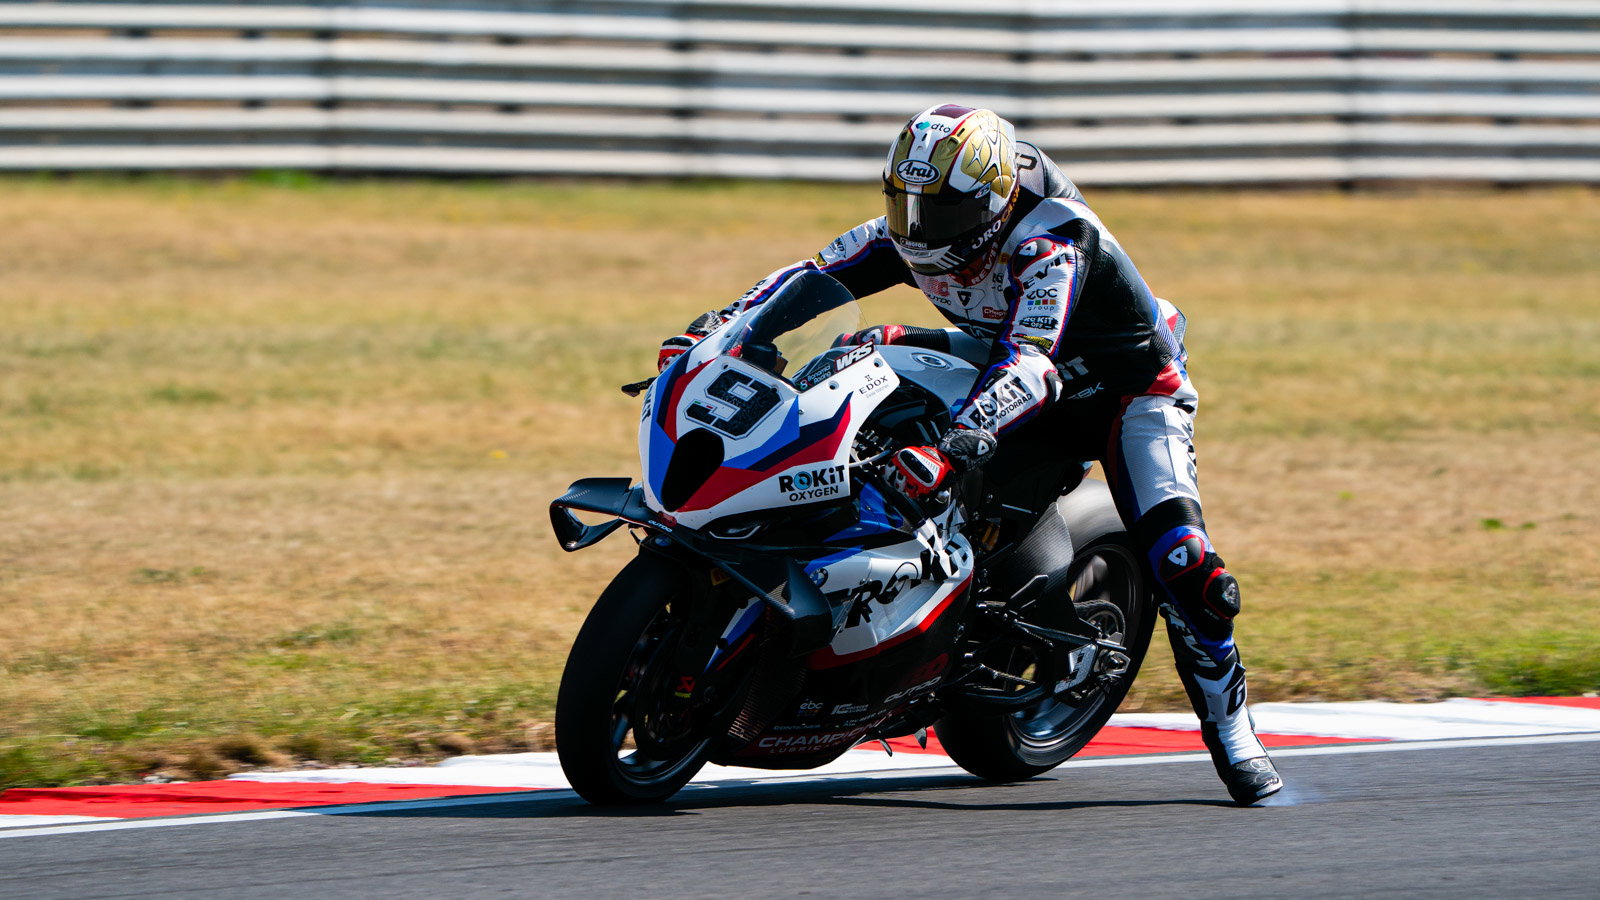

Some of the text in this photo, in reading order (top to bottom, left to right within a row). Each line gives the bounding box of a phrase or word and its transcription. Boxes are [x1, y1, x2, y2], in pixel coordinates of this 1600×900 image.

[930, 122, 951, 134] dto
[898, 161, 933, 178] Arai
[836, 340, 873, 371] WRS
[858, 375, 888, 395] EDOX
[995, 393, 1033, 420] MOTORRAD
[778, 465, 845, 493] ROKiT
[789, 486, 839, 503] OXYGEN
[799, 700, 824, 710] ebc
